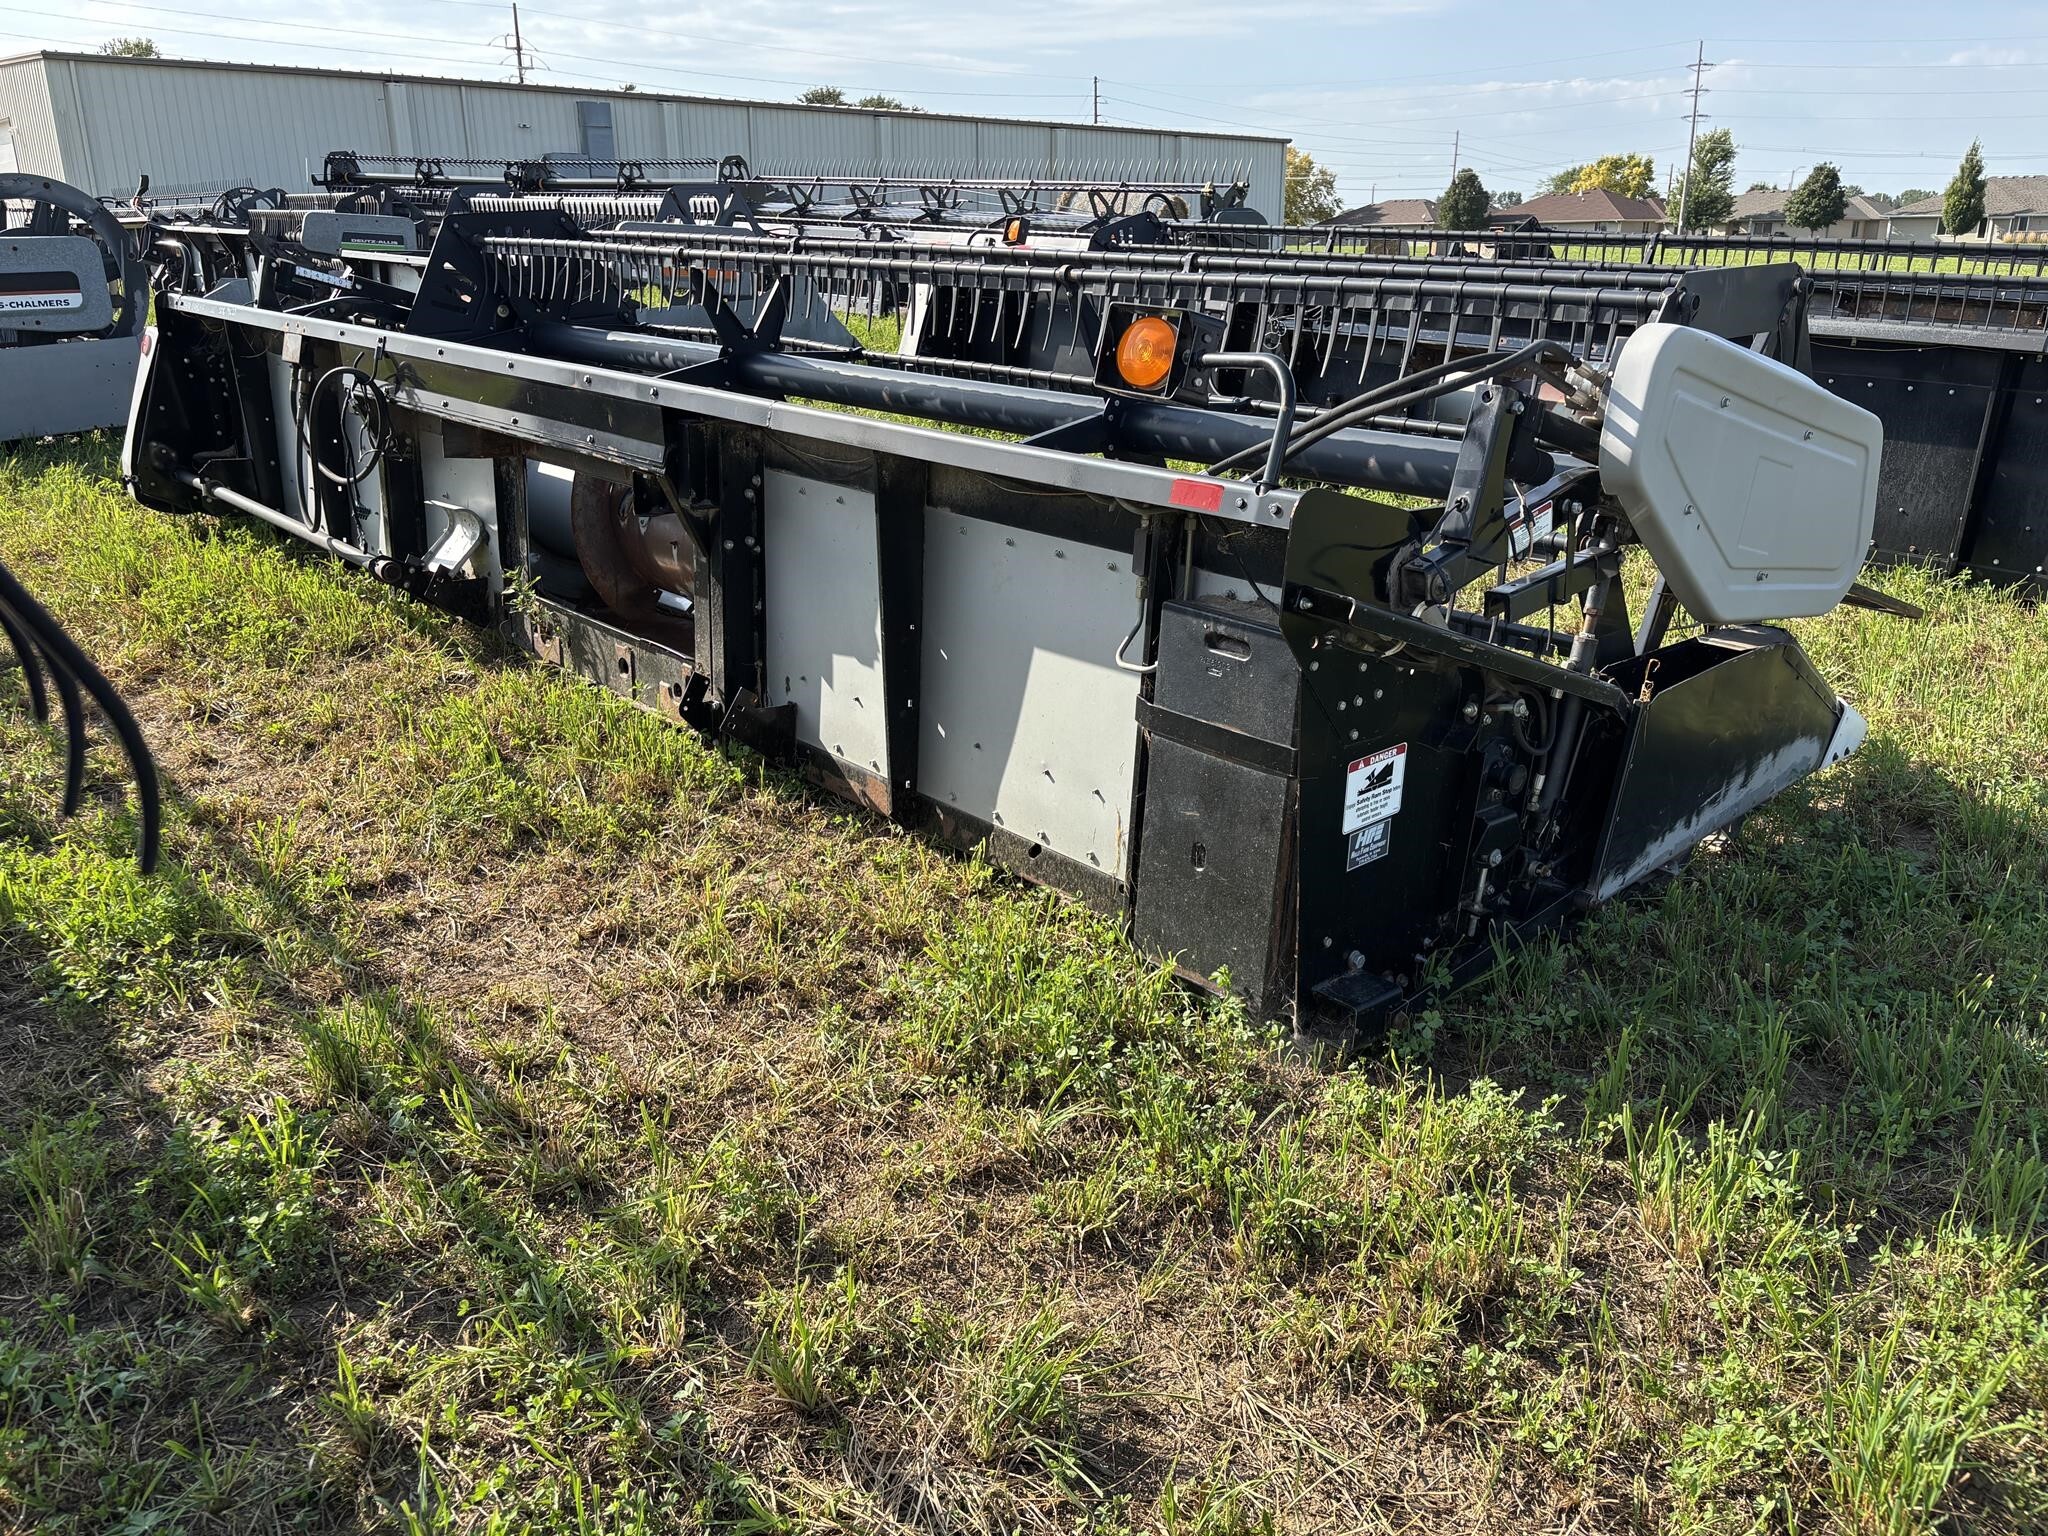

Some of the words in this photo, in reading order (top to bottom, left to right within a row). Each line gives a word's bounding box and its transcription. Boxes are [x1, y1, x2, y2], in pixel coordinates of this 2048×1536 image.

[1370, 749, 1397, 765] DANGER
[1357, 796, 1370, 806] Safety
[1382, 787, 1392, 796] Stop
